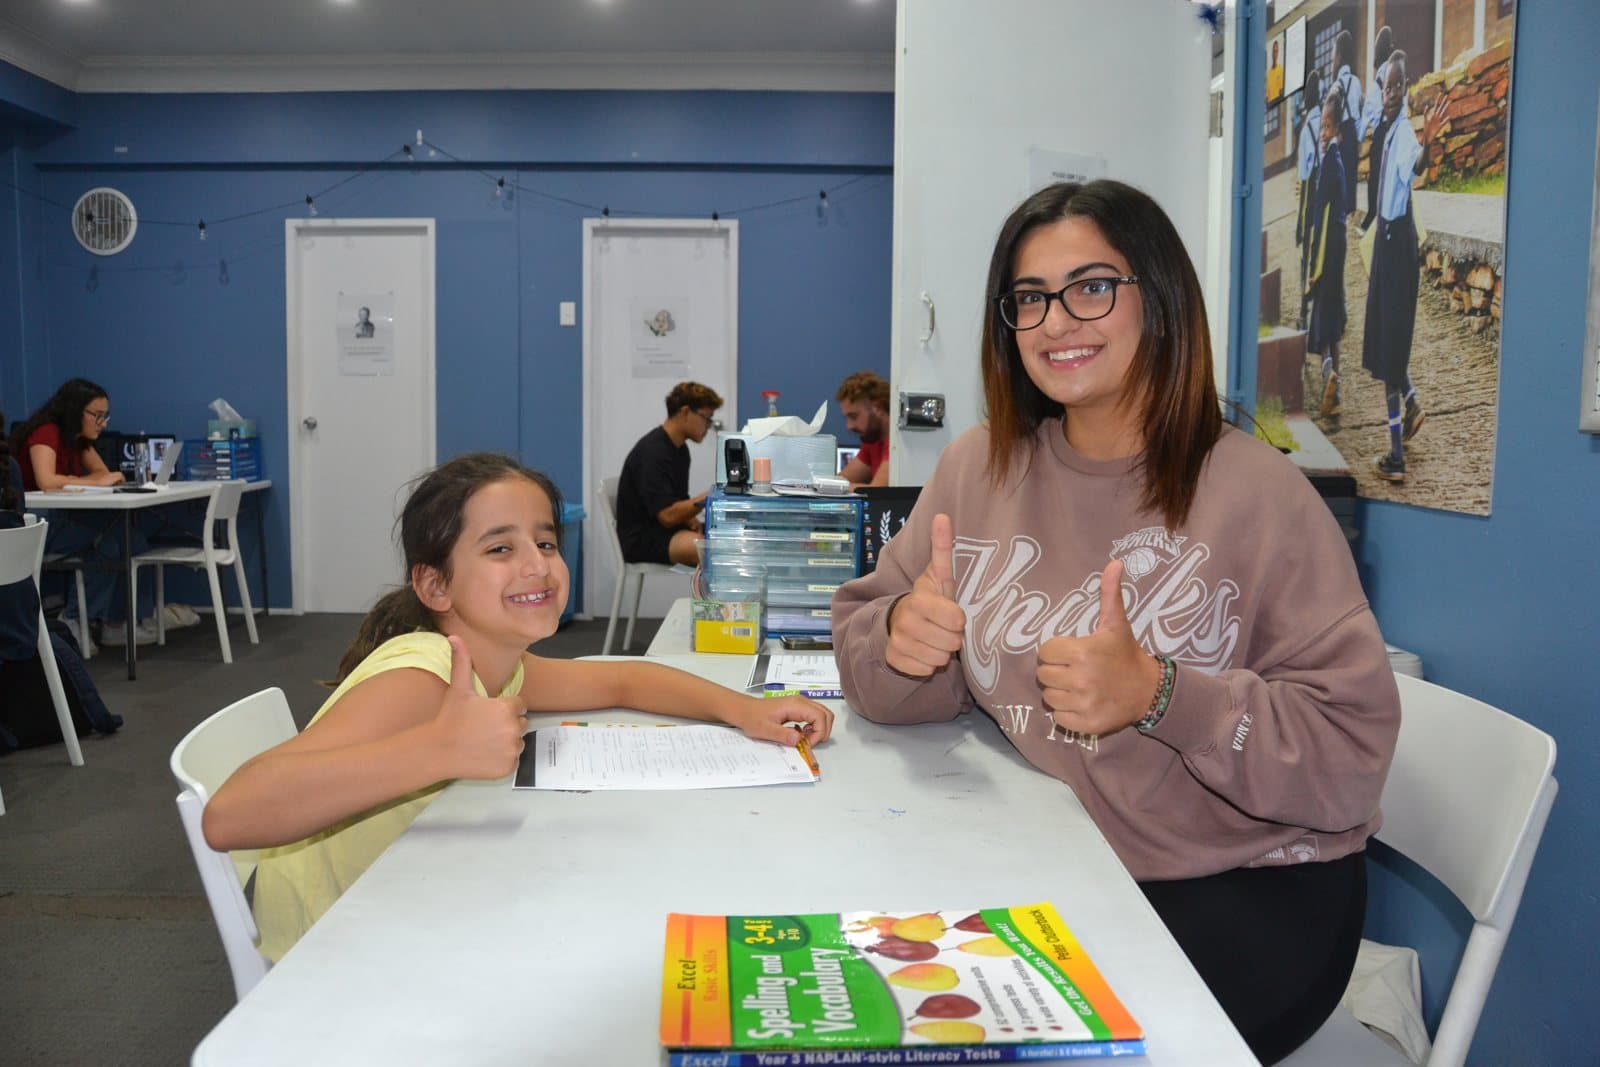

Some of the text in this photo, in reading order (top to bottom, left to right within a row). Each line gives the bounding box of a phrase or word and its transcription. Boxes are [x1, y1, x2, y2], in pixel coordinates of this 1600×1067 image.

[953, 535, 1241, 696] Kniks
[744, 924, 775, 944] 3-4
[1029, 908, 1073, 961] Peter Clutterbuck
[677, 959, 697, 991] Excel
[742, 954, 806, 1039] Spelling and
[799, 947, 857, 1033] Vocabulary
[995, 922, 1093, 1016] Get the Results You Want!
[681, 1053, 729, 1067] Excel
[756, 1053, 788, 1065] Year
[792, 1053, 800, 1064] 3
[905, 1049, 960, 1062] Literacy
[965, 1049, 1001, 1060] Tests
